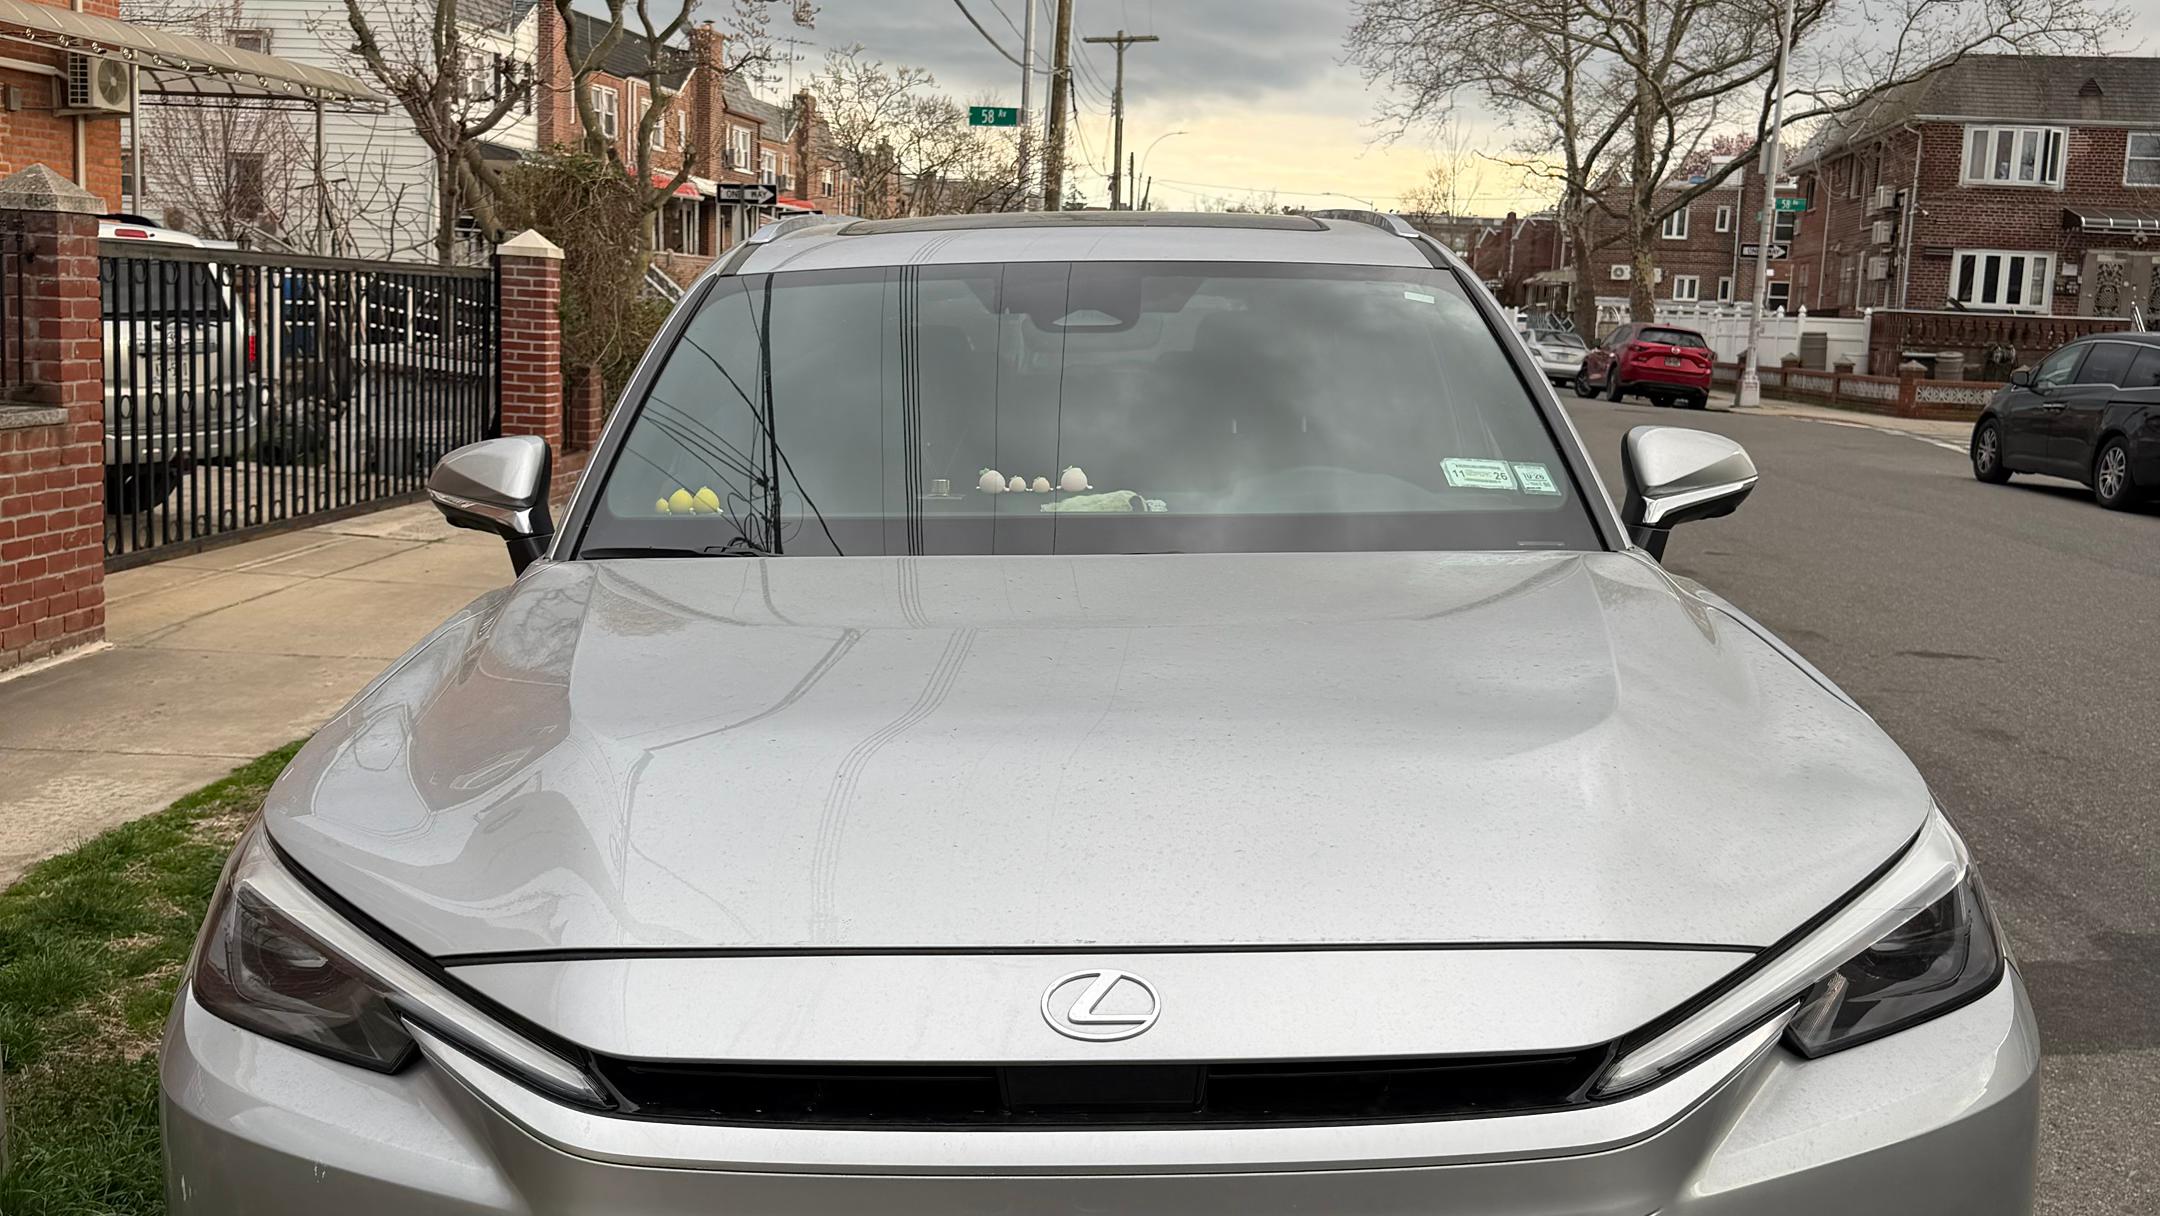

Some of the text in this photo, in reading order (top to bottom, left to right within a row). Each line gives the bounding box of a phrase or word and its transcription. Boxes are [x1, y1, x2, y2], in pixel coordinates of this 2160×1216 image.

[981, 109, 1006, 124] 58 Av
[751, 191, 767, 199] WAY
[1781, 200, 1790, 209] 58
[1453, 469, 1465, 478] 11
[1494, 471, 1508, 481] 26
